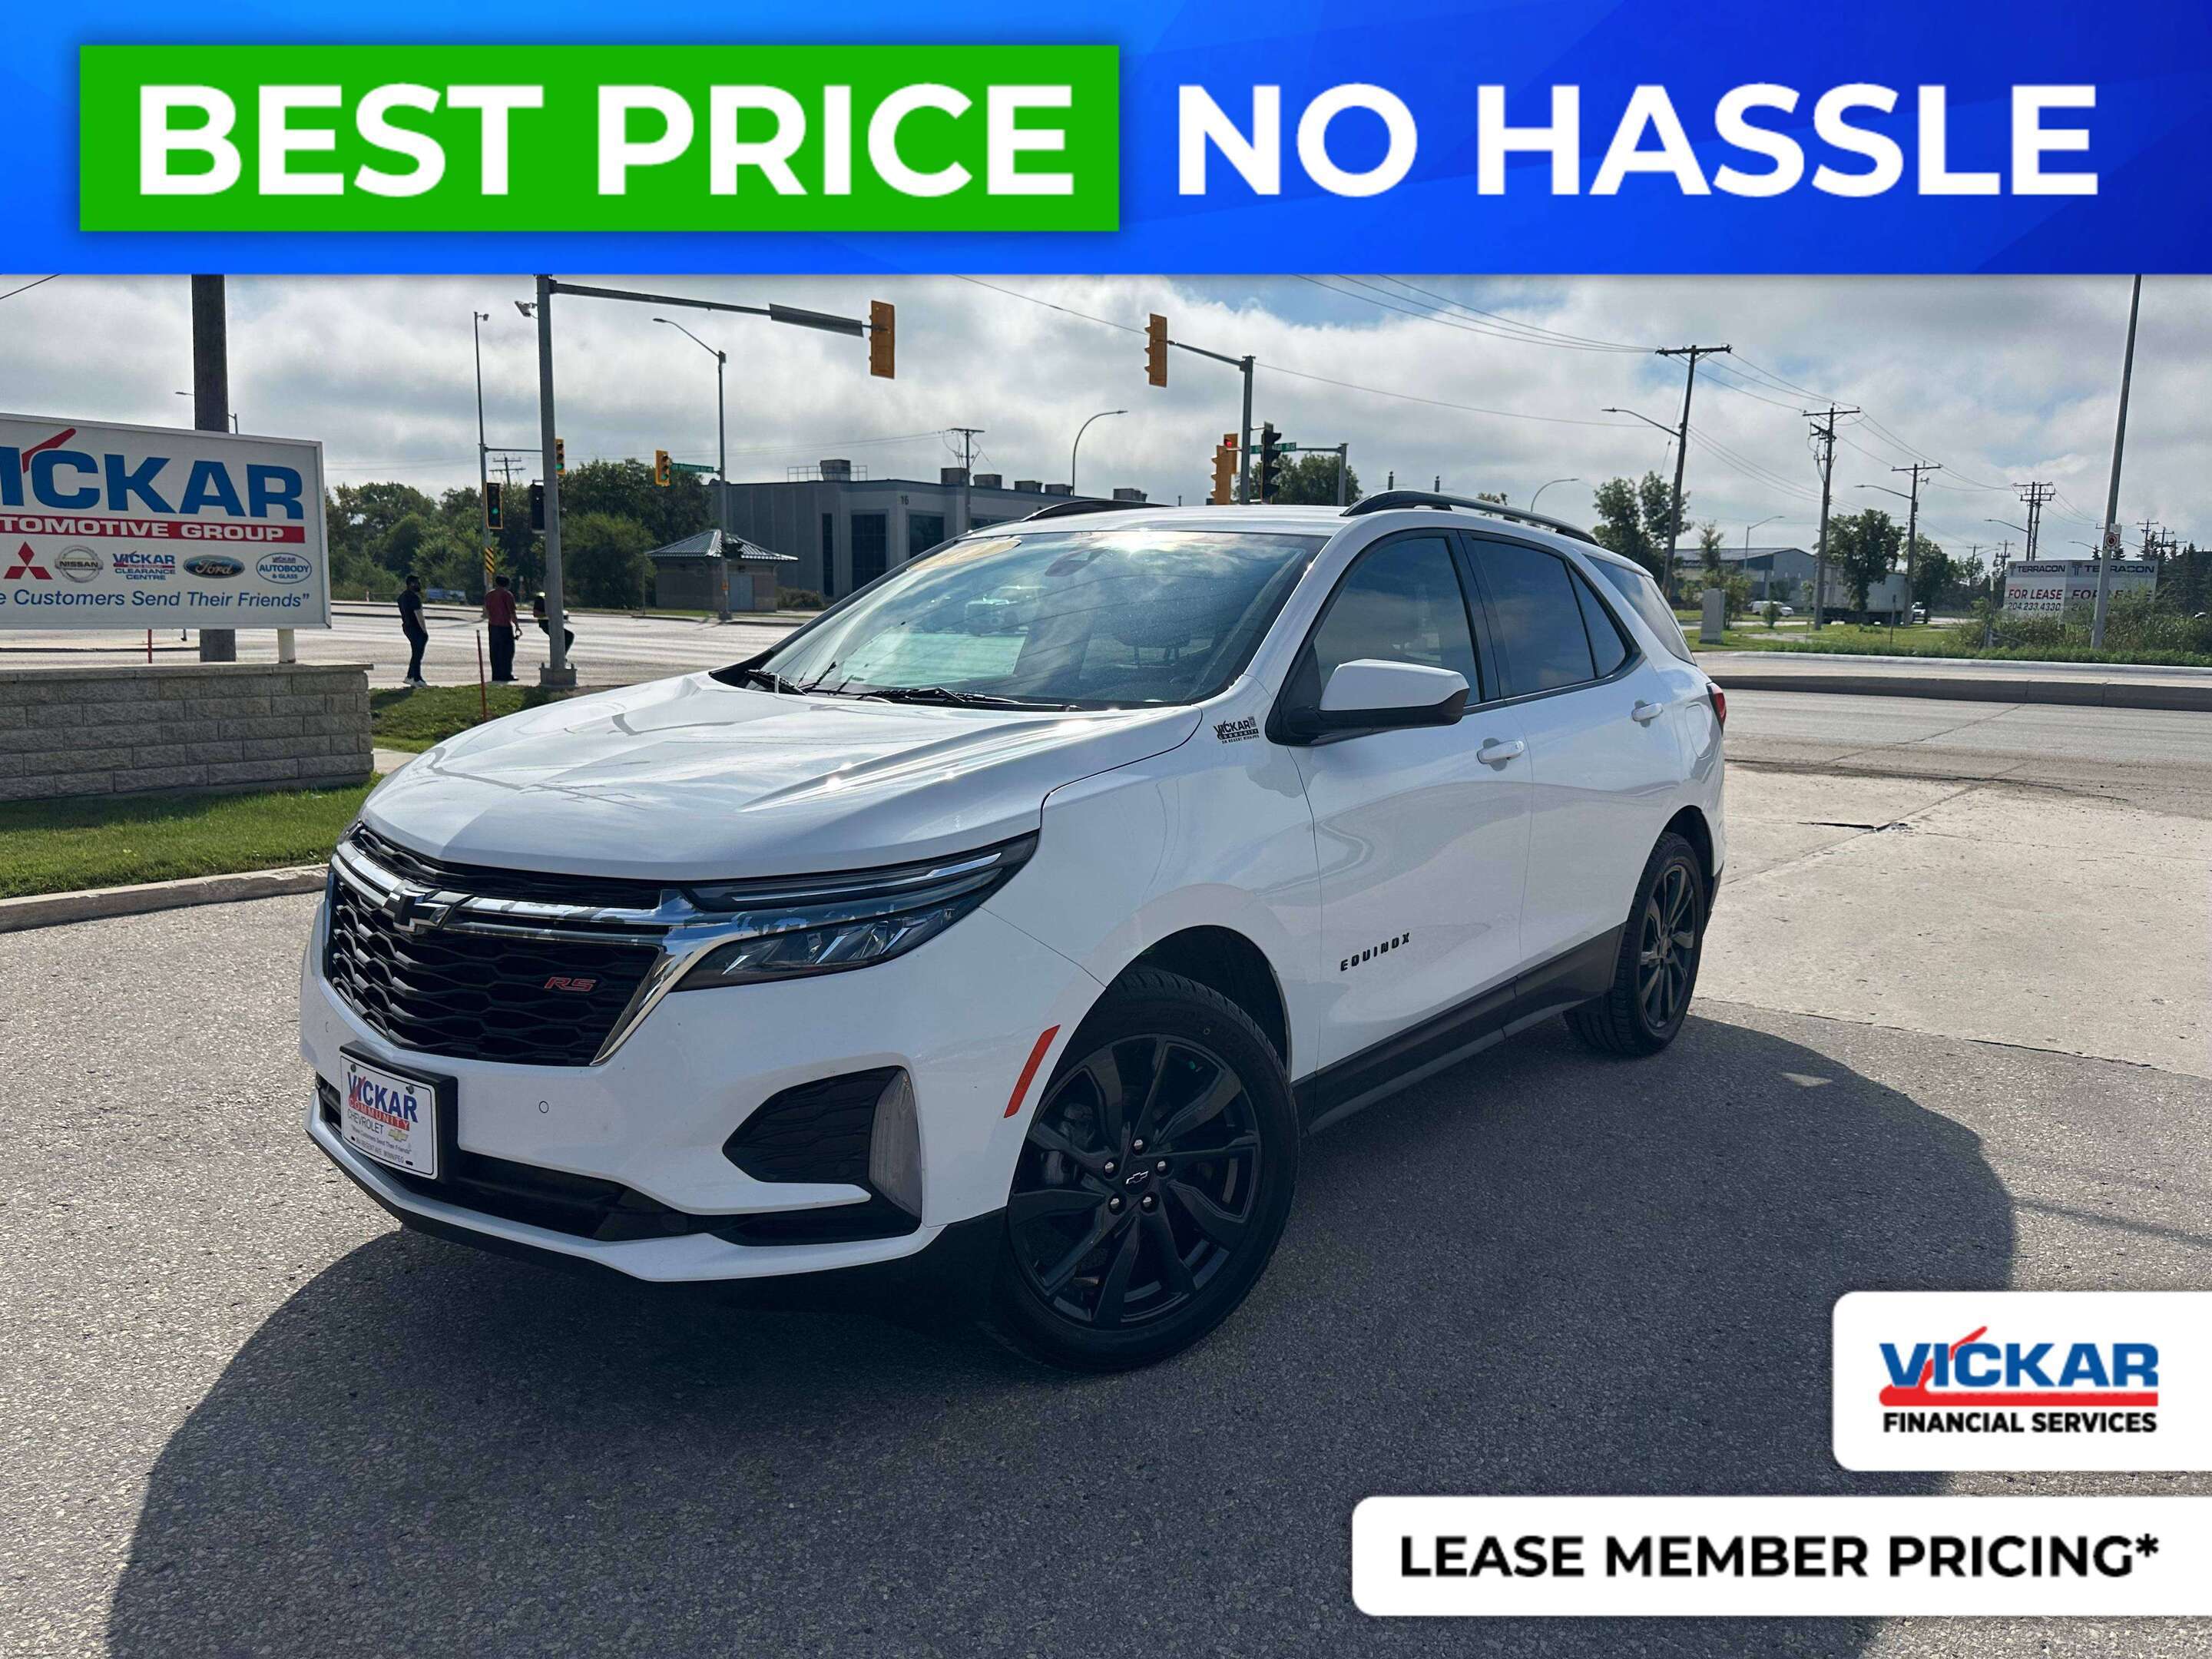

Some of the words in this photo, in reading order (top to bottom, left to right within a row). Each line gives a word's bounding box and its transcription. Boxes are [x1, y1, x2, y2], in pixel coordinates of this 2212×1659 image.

[900, 495, 909, 505] 16
[0, 516, 169, 538] TOMOTIVE
[180, 523, 284, 541] GROUP
[112, 552, 176, 565] VICKAR
[195, 559, 233, 575] Ford
[259, 565, 310, 573] AUTOBODY
[2018, 565, 2066, 573] TERRACON
[2084, 565, 2155, 573] TERACON
[14, 589, 124, 606] Customers
[131, 590, 181, 607] Send
[187, 591, 233, 607] Their
[2008, 588, 2028, 599] FOR
[2030, 589, 2064, 600] LEASE
[2008, 601, 2061, 611] 204.233.4330
[1213, 720, 1251, 733] VICKAR
[1340, 932, 1410, 972] EQUINOX
[544, 976, 597, 992] RS
[347, 1071, 419, 1123] VICKAR
[347, 1108, 384, 1134] CHEVROLET
[349, 1097, 410, 1131] COMMUNITY
